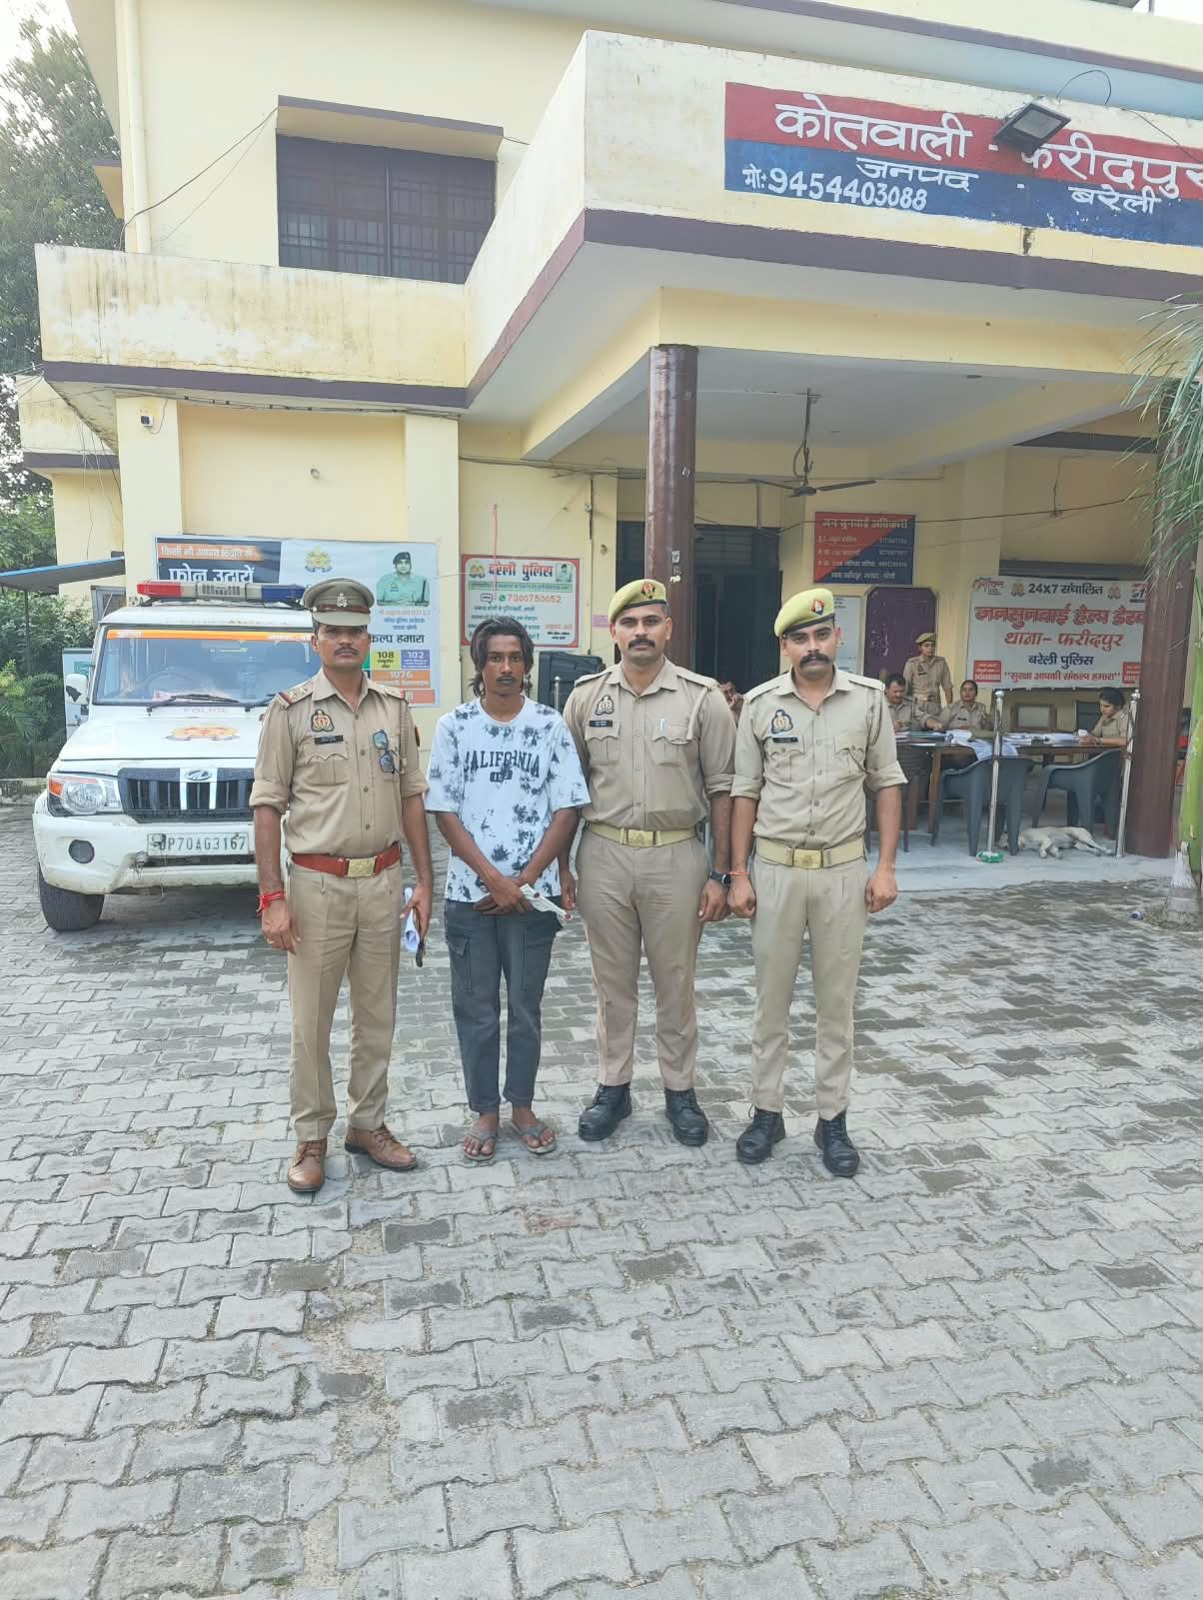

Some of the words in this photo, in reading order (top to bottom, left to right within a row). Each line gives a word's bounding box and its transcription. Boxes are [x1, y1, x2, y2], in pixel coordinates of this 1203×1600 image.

[775, 92, 973, 161] कोतवाली
[768, 167, 928, 211] 9454403088
[856, 157, 979, 192] जनपद
[1068, 184, 1162, 215] बरेली
[488, 561, 517, 576] बरेली
[522, 562, 553, 581] पुलिस
[1061, 582, 1103, 595] संचालित
[1057, 629, 1125, 651] फरीदपुर
[1028, 652, 1058, 665] बरेली
[1060, 652, 1094, 669] पुलिस
